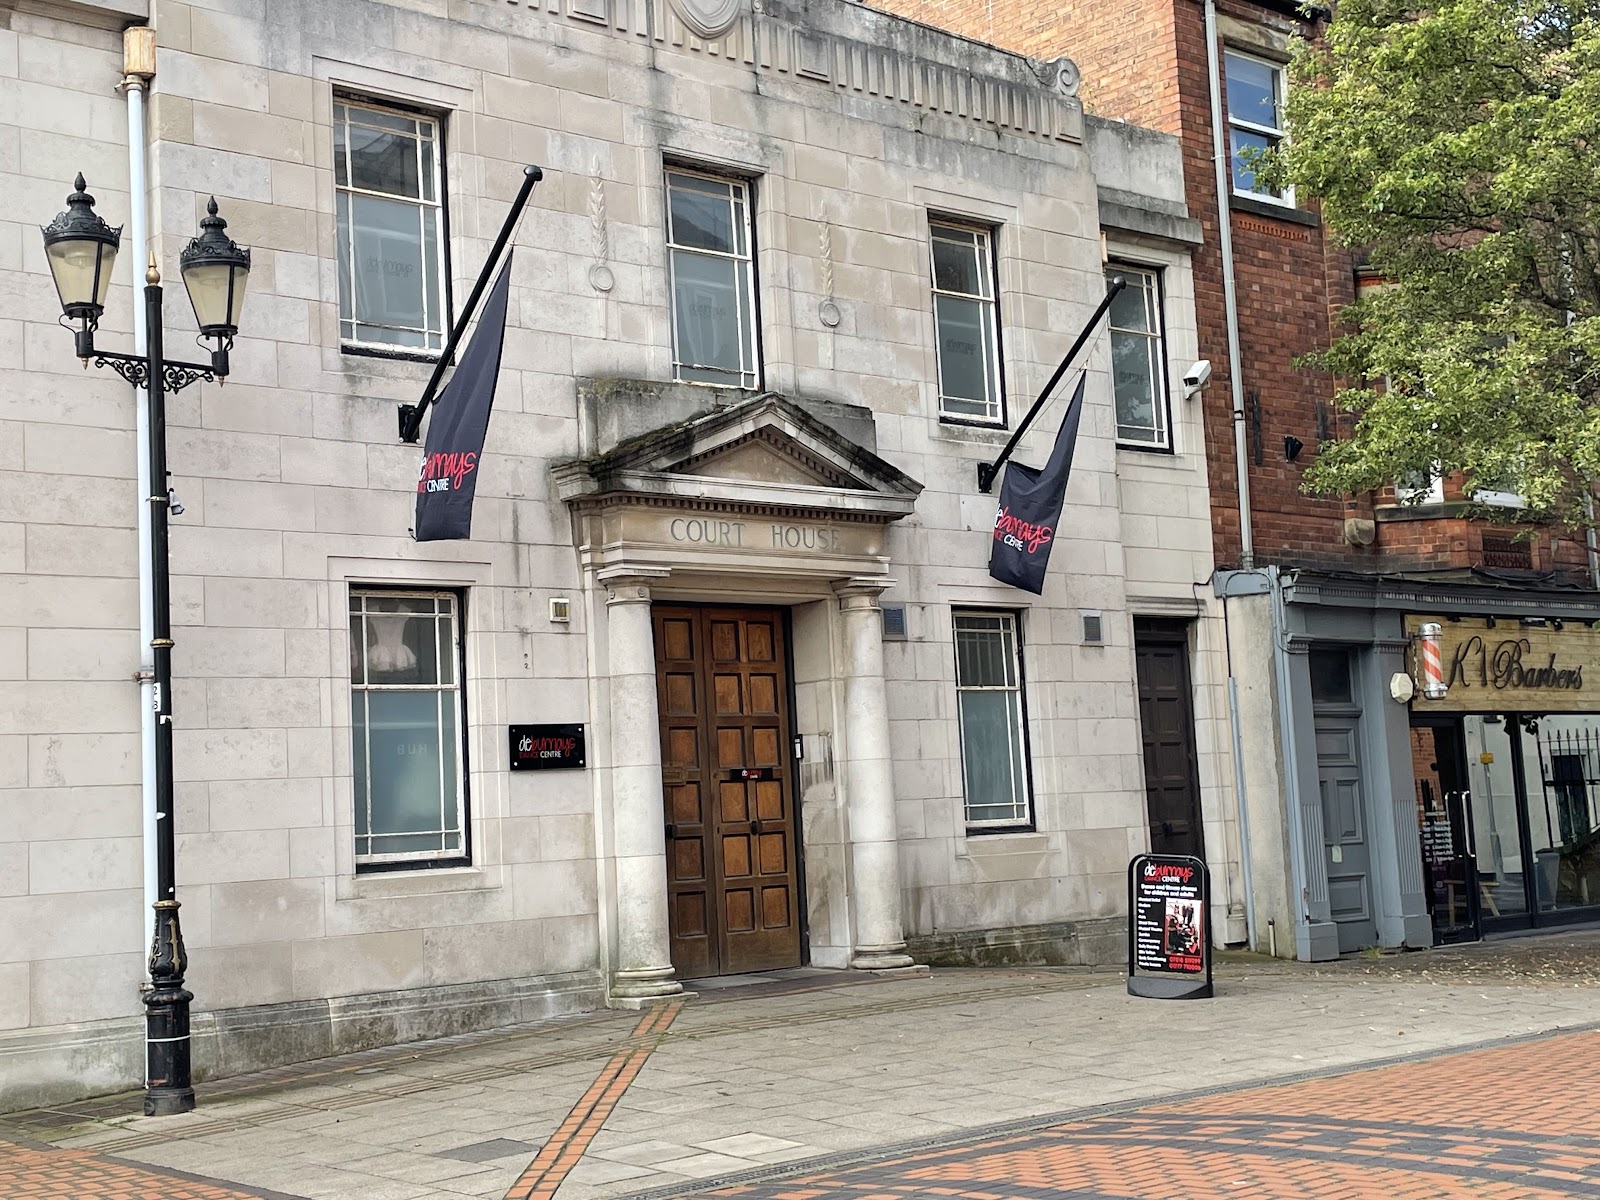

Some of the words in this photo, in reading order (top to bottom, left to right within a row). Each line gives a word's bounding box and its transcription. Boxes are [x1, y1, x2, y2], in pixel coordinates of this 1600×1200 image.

[671, 518, 747, 547] COURT
[771, 525, 841, 550] HOUSE
[1492, 638, 1583, 690] Barbers
[539, 750, 562, 759] CENTRE
